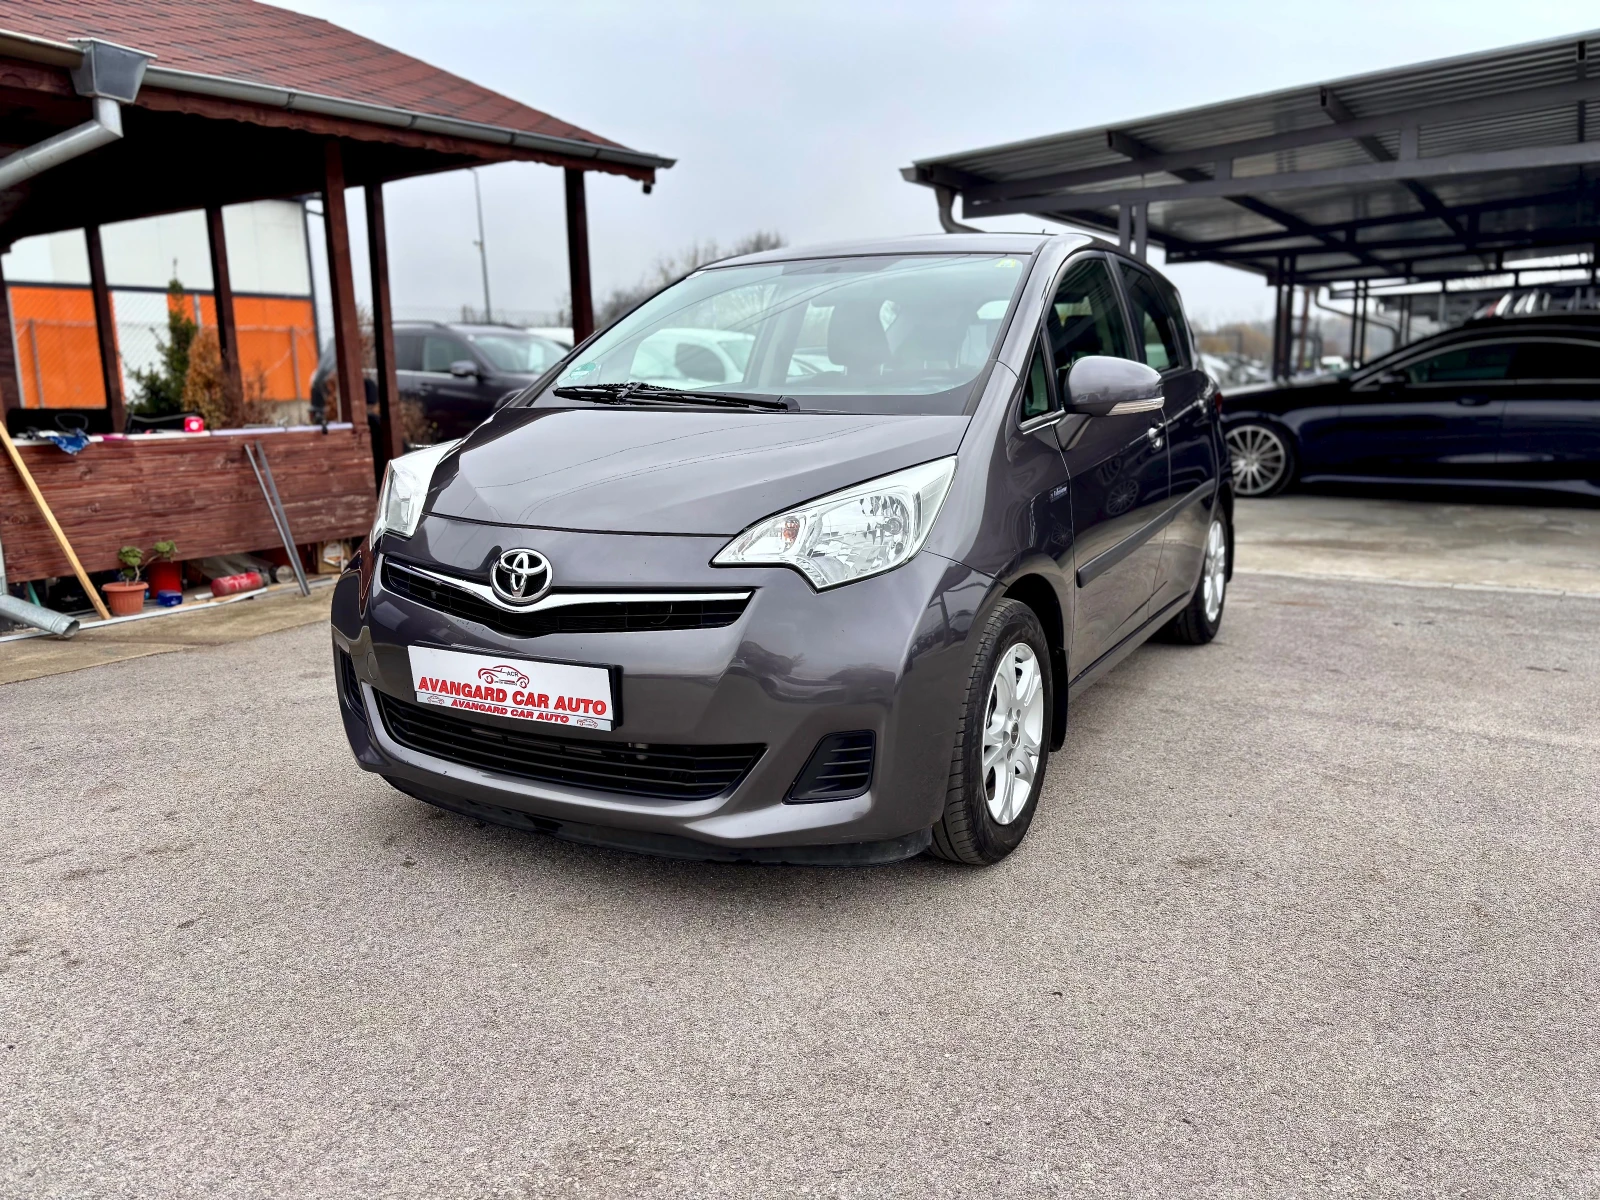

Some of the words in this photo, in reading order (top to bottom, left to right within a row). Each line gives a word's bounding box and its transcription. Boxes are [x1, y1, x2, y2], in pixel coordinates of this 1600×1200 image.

[418, 676, 508, 703] AVANGARD
[512, 690, 550, 709] CAR
[553, 695, 607, 715] AUTO
[451, 699, 508, 715] AVANGARD
[510, 709, 534, 719] CAR
[536, 712, 570, 724] AUTO
